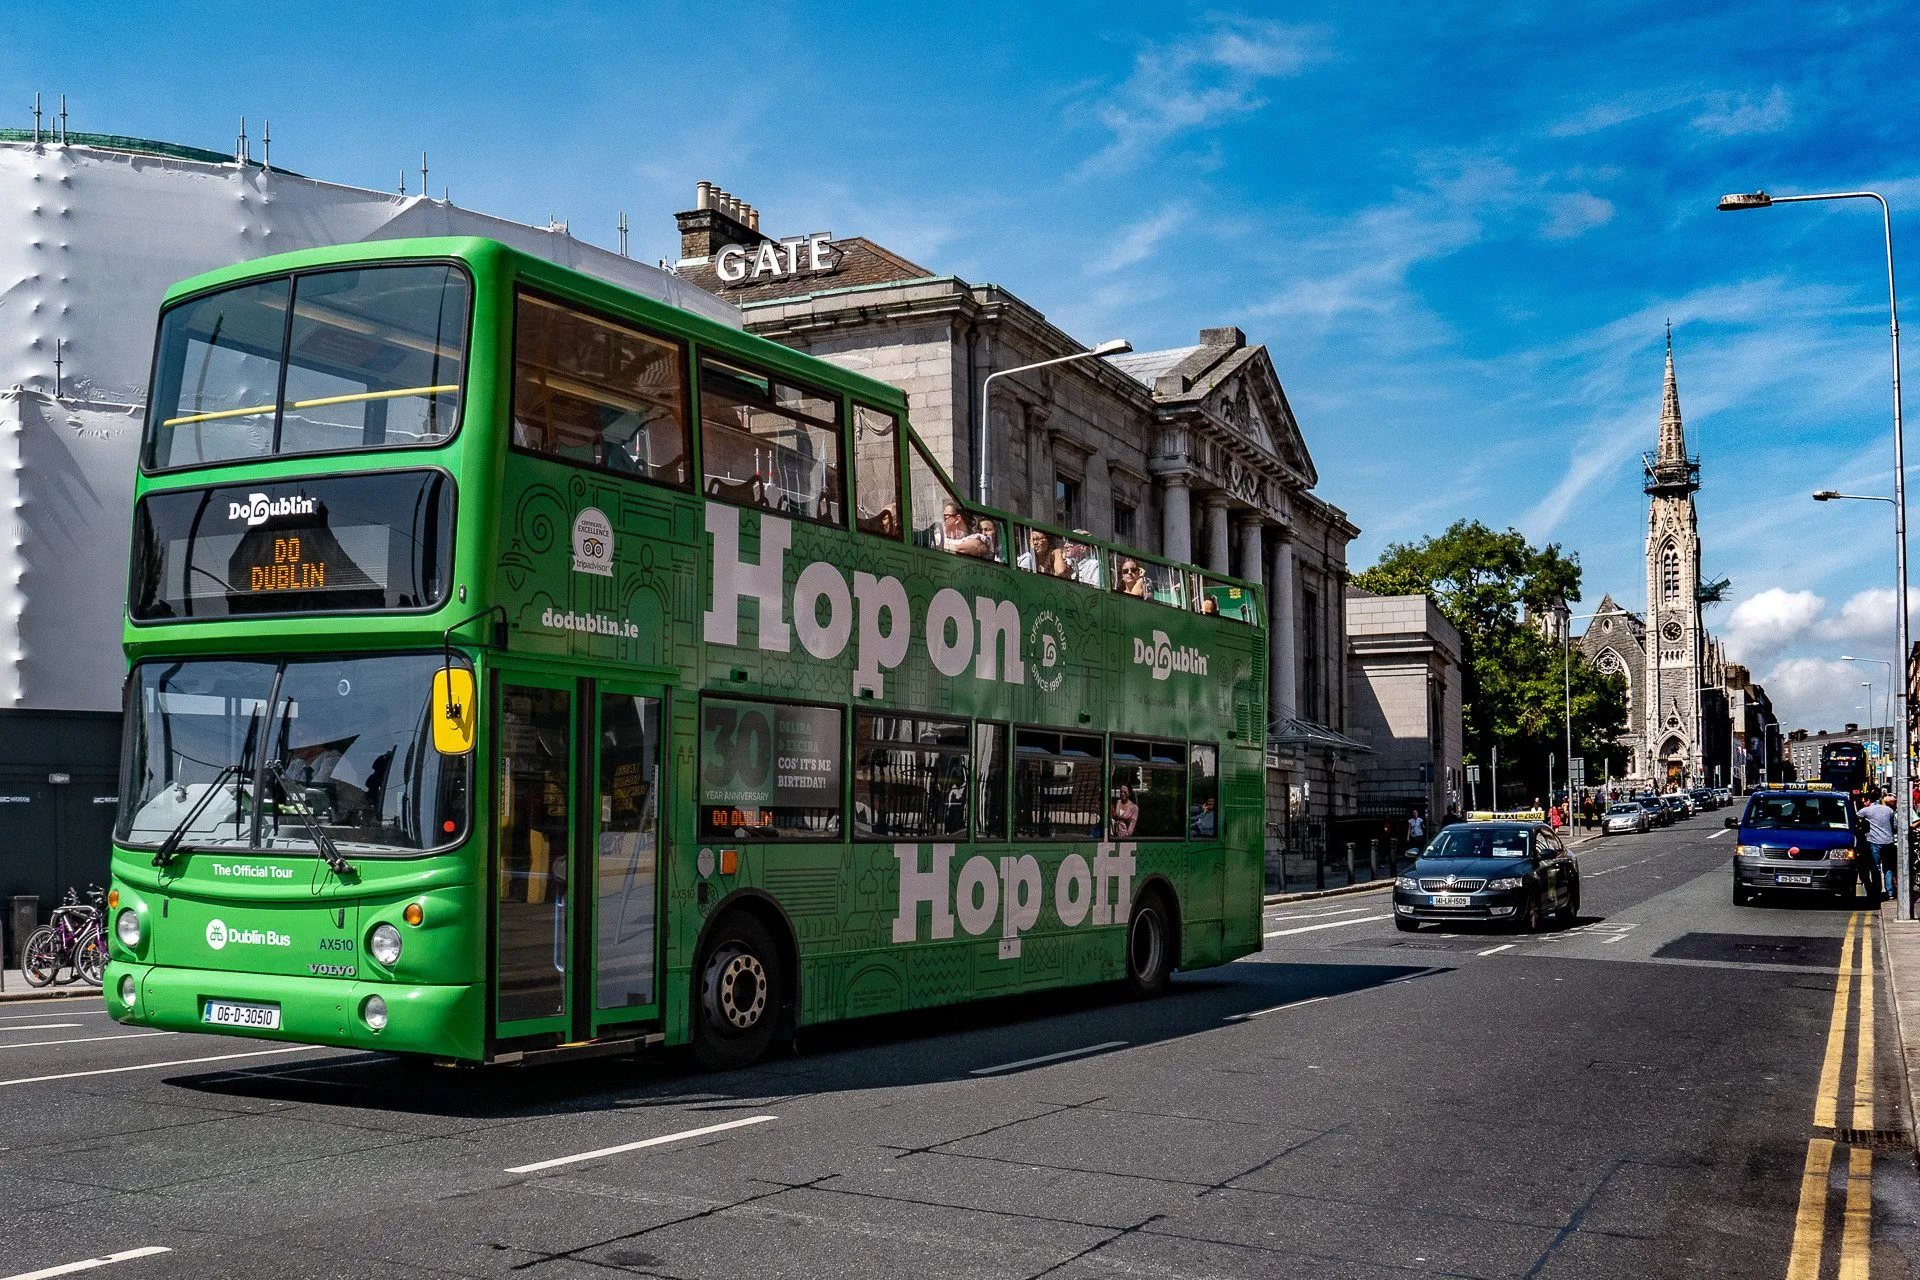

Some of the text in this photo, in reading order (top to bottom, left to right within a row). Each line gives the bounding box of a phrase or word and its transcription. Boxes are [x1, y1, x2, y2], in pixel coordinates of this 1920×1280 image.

[716, 231, 833, 281] GATE
[228, 492, 313, 526] DoDublin
[578, 525, 609, 537] EXCELLENCE
[275, 538, 300, 563] DO
[252, 562, 325, 591] DUBLIN
[576, 560, 609, 572] tripadvisor
[703, 501, 1025, 699] Hop on
[542, 608, 639, 638] dodublin.ie
[1031, 610, 1067, 651] OFFICIAL TOUR
[1134, 630, 1208, 680] DoDublin
[1031, 663, 1062, 692] SINCE 1988
[704, 707, 772, 789] 30
[800, 758, 817, 771] IT'S
[818, 759, 832, 772] ME
[778, 775, 826, 789] BIRTHDAY!
[705, 790, 769, 801] YEAR ANNIVERSARY
[213, 863, 294, 879] The Official Tour
[671, 889, 695, 899] AX510
[892, 842, 1137, 960] Hop off
[229, 928, 291, 947] Dublin Bus
[320, 939, 354, 951] AX510
[307, 964, 356, 977] VOLVO
[217, 1006, 273, 1025] 06-D-30510
